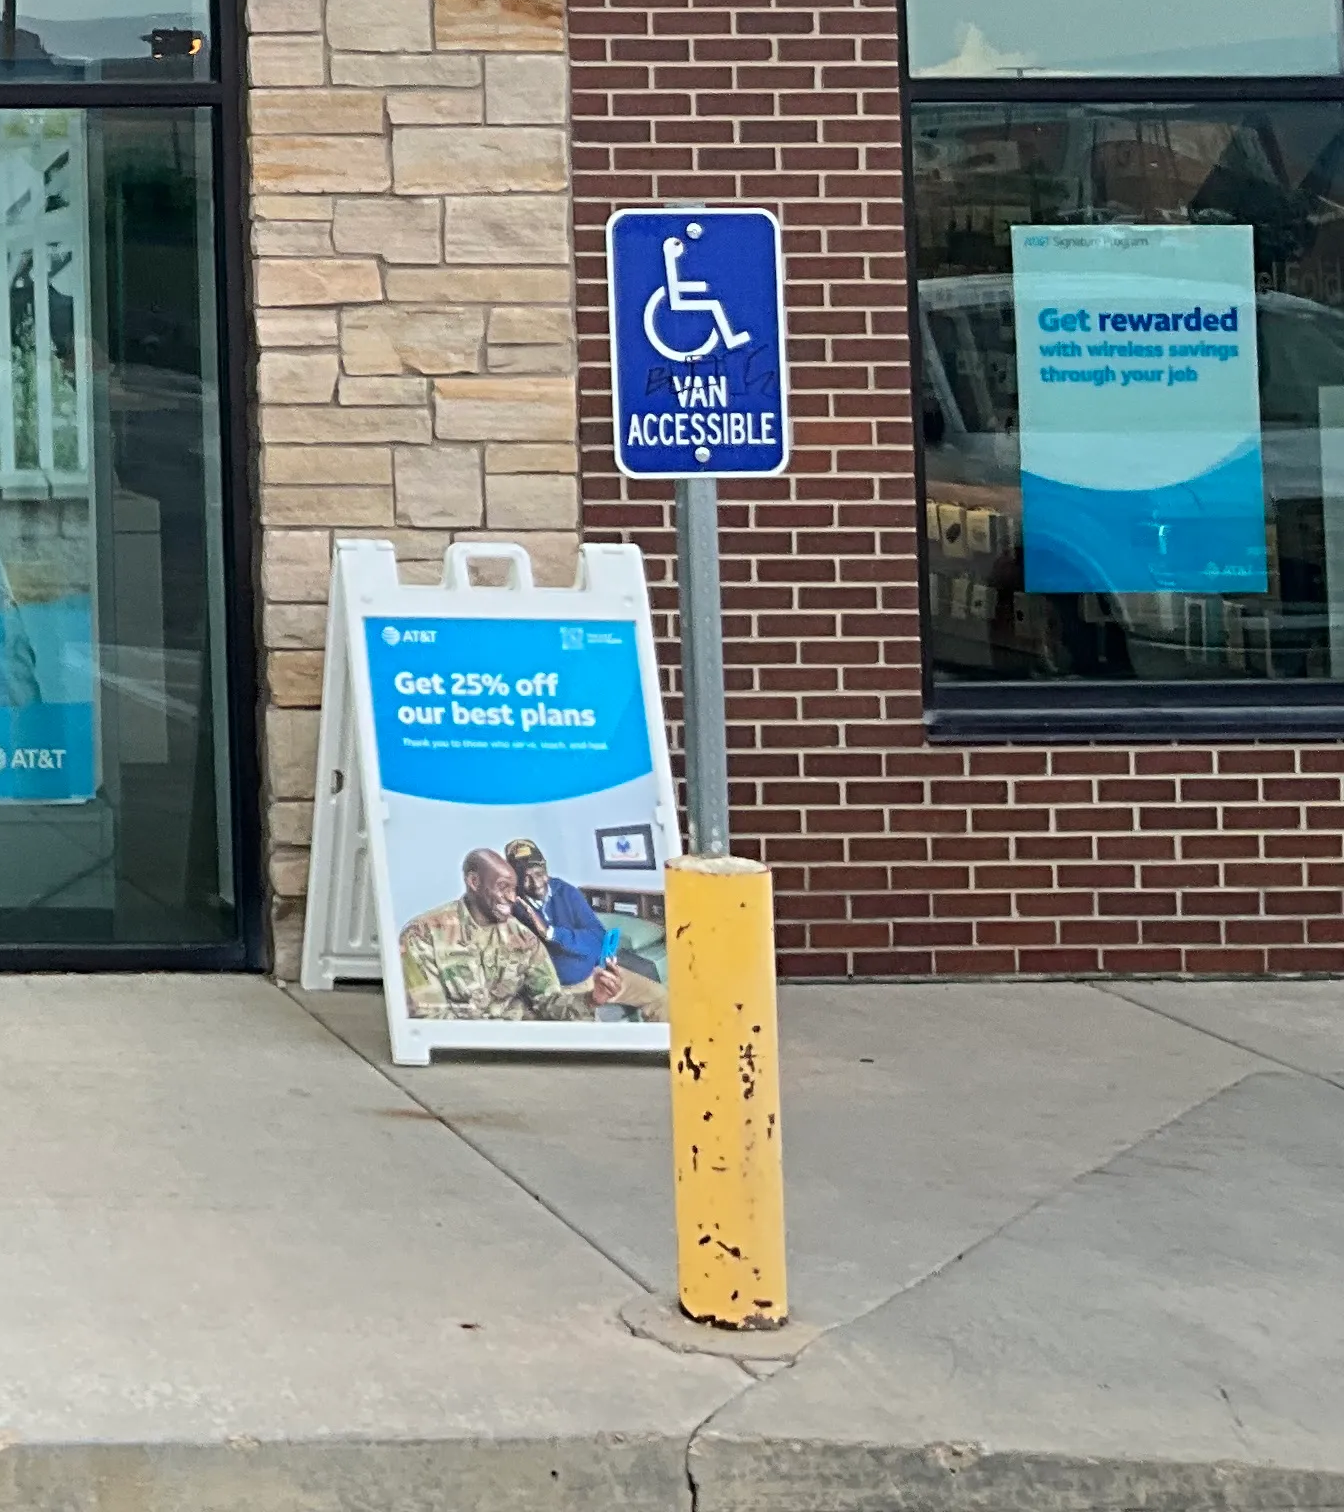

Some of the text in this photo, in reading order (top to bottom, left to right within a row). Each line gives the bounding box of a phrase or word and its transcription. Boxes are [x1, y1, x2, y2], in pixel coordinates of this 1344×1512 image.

[1038, 306, 1239, 333] Get rewarded
[1039, 341, 1239, 361] with wireless savings
[1040, 365, 1198, 386] through your job
[672, 375, 727, 408] VAN
[627, 412, 777, 446] ACCESSIBLE
[402, 630, 437, 643] AT&T
[394, 671, 559, 697] Get 25% off
[398, 700, 597, 732] our best plans
[11, 749, 67, 769] AT&T
